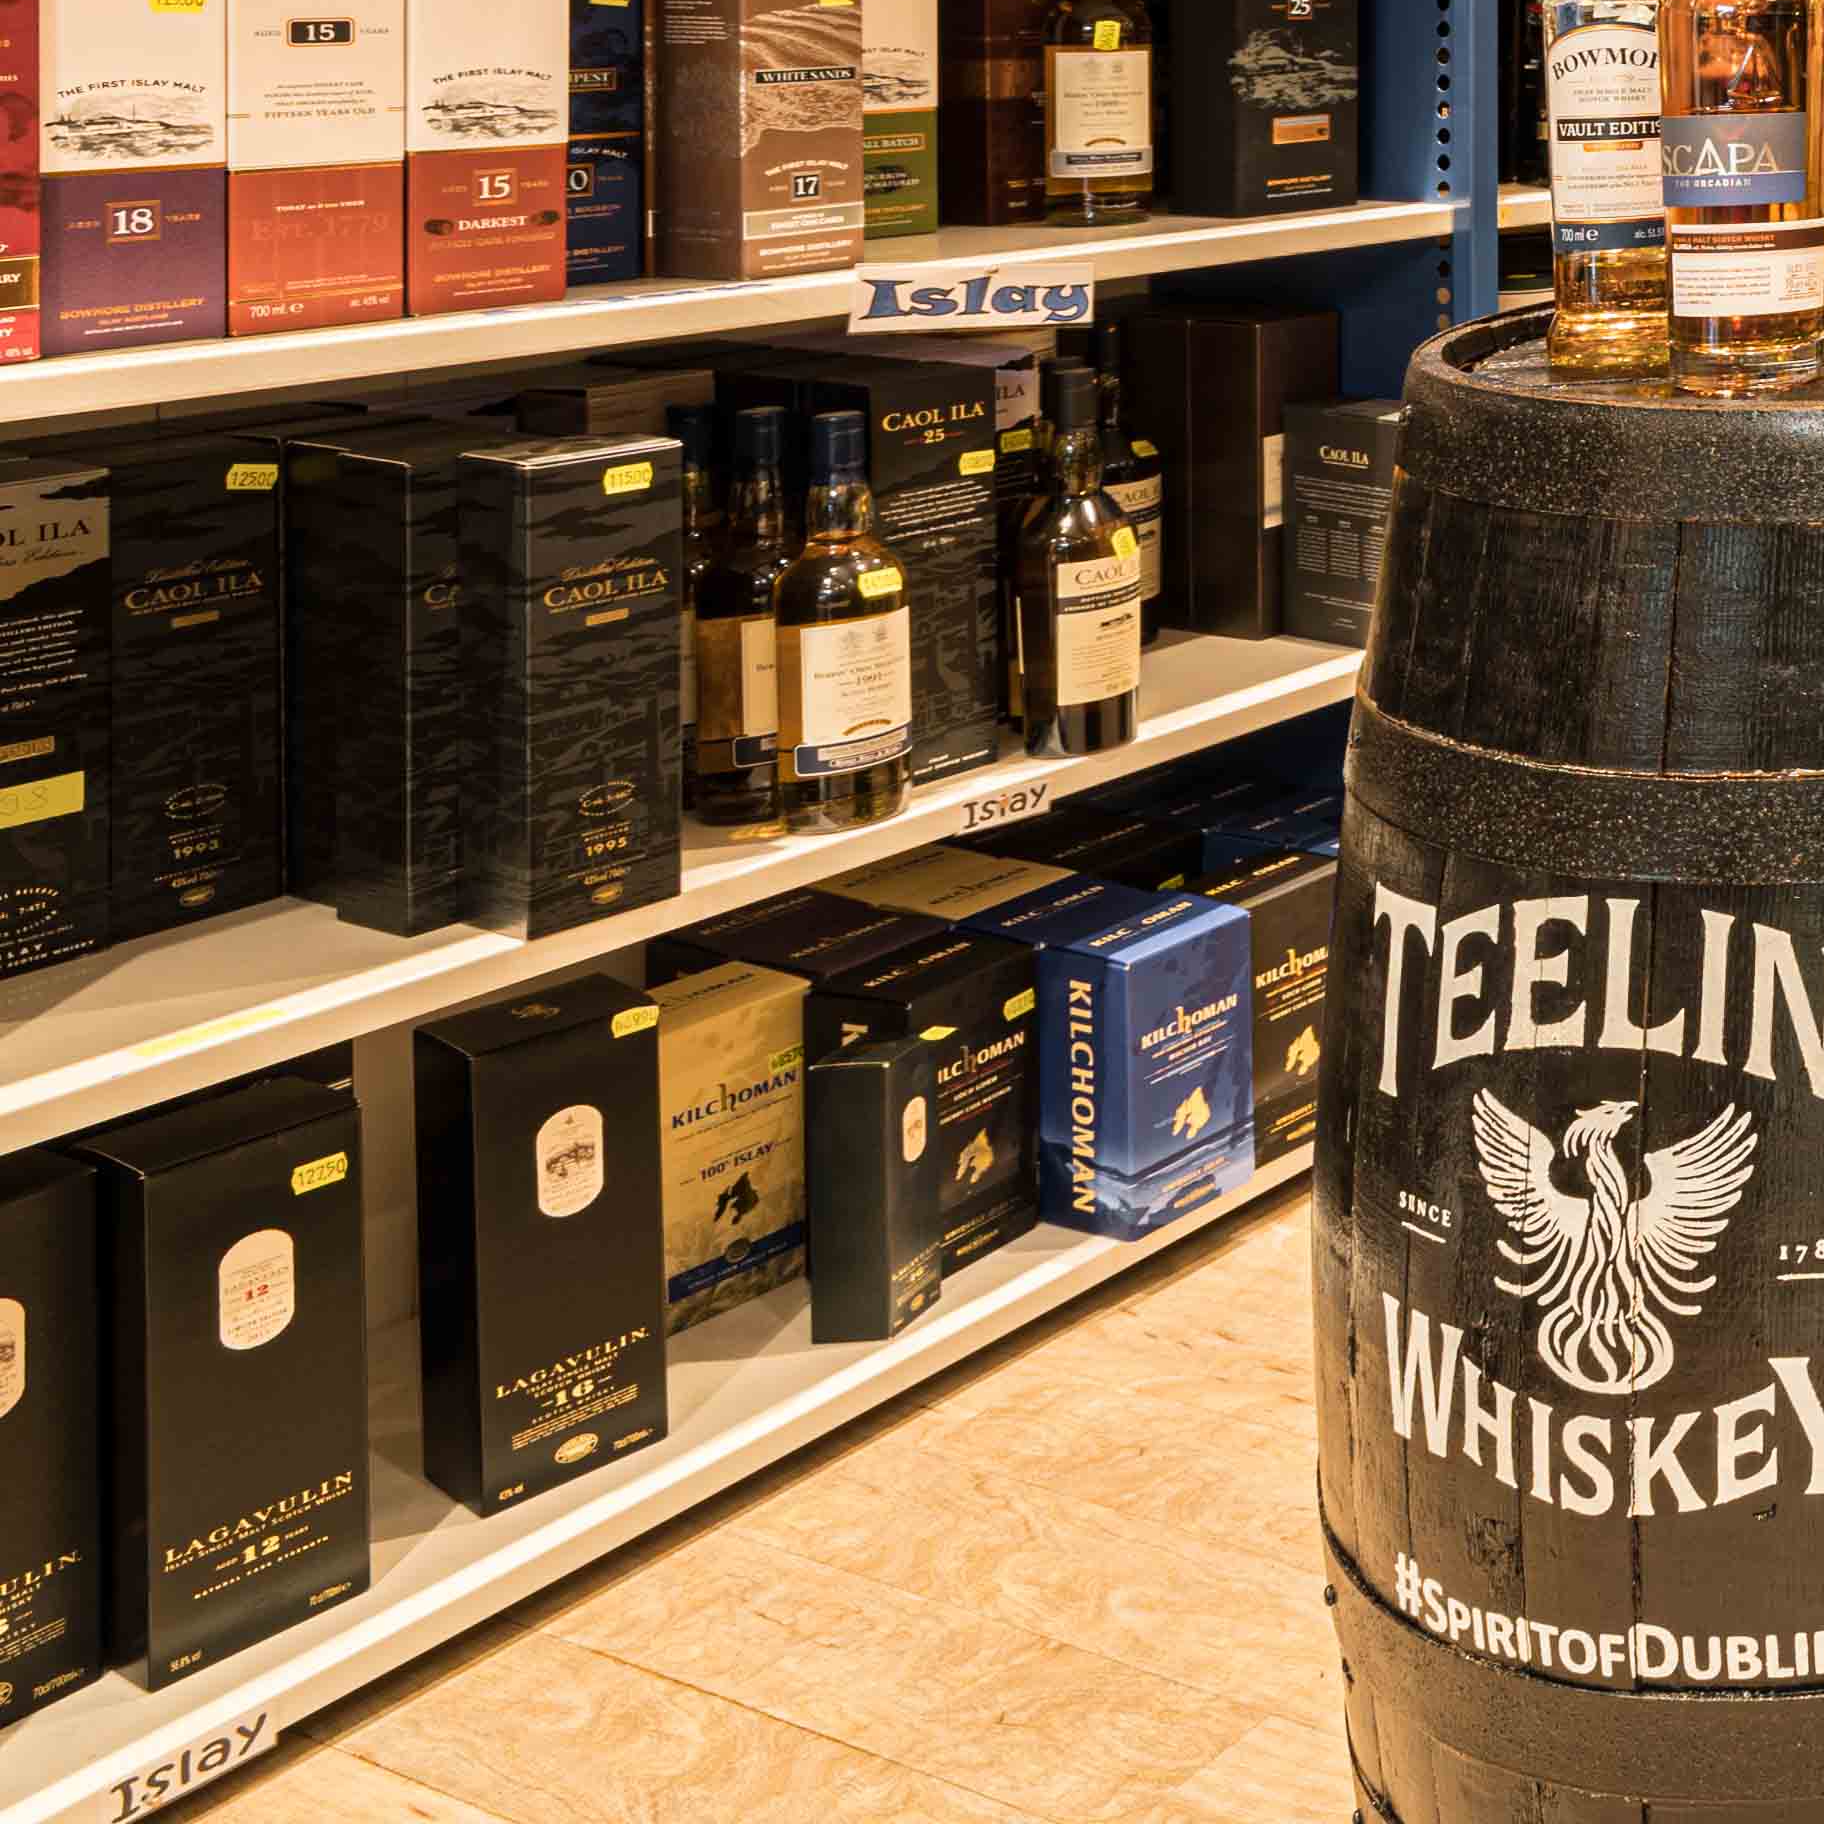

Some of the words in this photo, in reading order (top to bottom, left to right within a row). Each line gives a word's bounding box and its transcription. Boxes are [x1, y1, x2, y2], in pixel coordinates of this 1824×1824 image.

[305, 24, 336, 42] 15
[57, 86, 84, 99] THE
[88, 79, 127, 92] FIRST
[130, 78, 170, 89] ISLAY
[173, 81, 208, 94] MALT
[432, 74, 454, 85] THE
[458, 69, 489, 79] FIRST
[492, 67, 524, 76] ISLAY
[525, 71, 553, 81] MALT
[1558, 120, 1606, 138] VAULT
[1662, 137, 1778, 177] SCAPA
[478, 174, 511, 200] 15
[794, 175, 819, 197] 17
[111, 206, 154, 237] 18
[458, 215, 528, 232] DARKEST
[858, 276, 1090, 325] Islay
[882, 407, 945, 433] CAOL
[950, 402, 985, 420] ILA
[922, 428, 946, 445] 25
[38, 517, 92, 542] ILA
[124, 581, 206, 613] CAOL
[215, 571, 265, 596] ILA
[541, 577, 620, 610] CAOL
[627, 567, 670, 594] ILA
[962, 782, 1048, 831] Islay
[1140, 992, 1239, 1051] KILCHOMAN
[671, 1069, 799, 1130] KILCHOMAN
[1069, 979, 1097, 1214] KILCHOMAN
[732, 1140, 774, 1166] ISLAY
[1398, 1190, 1454, 1229] SINCE
[495, 1326, 648, 1400] LAGAVULIN
[163, 1470, 354, 1564] LAGAVULIN
[240, 1533, 283, 1566] 12
[111, 1711, 269, 1824] Islay
